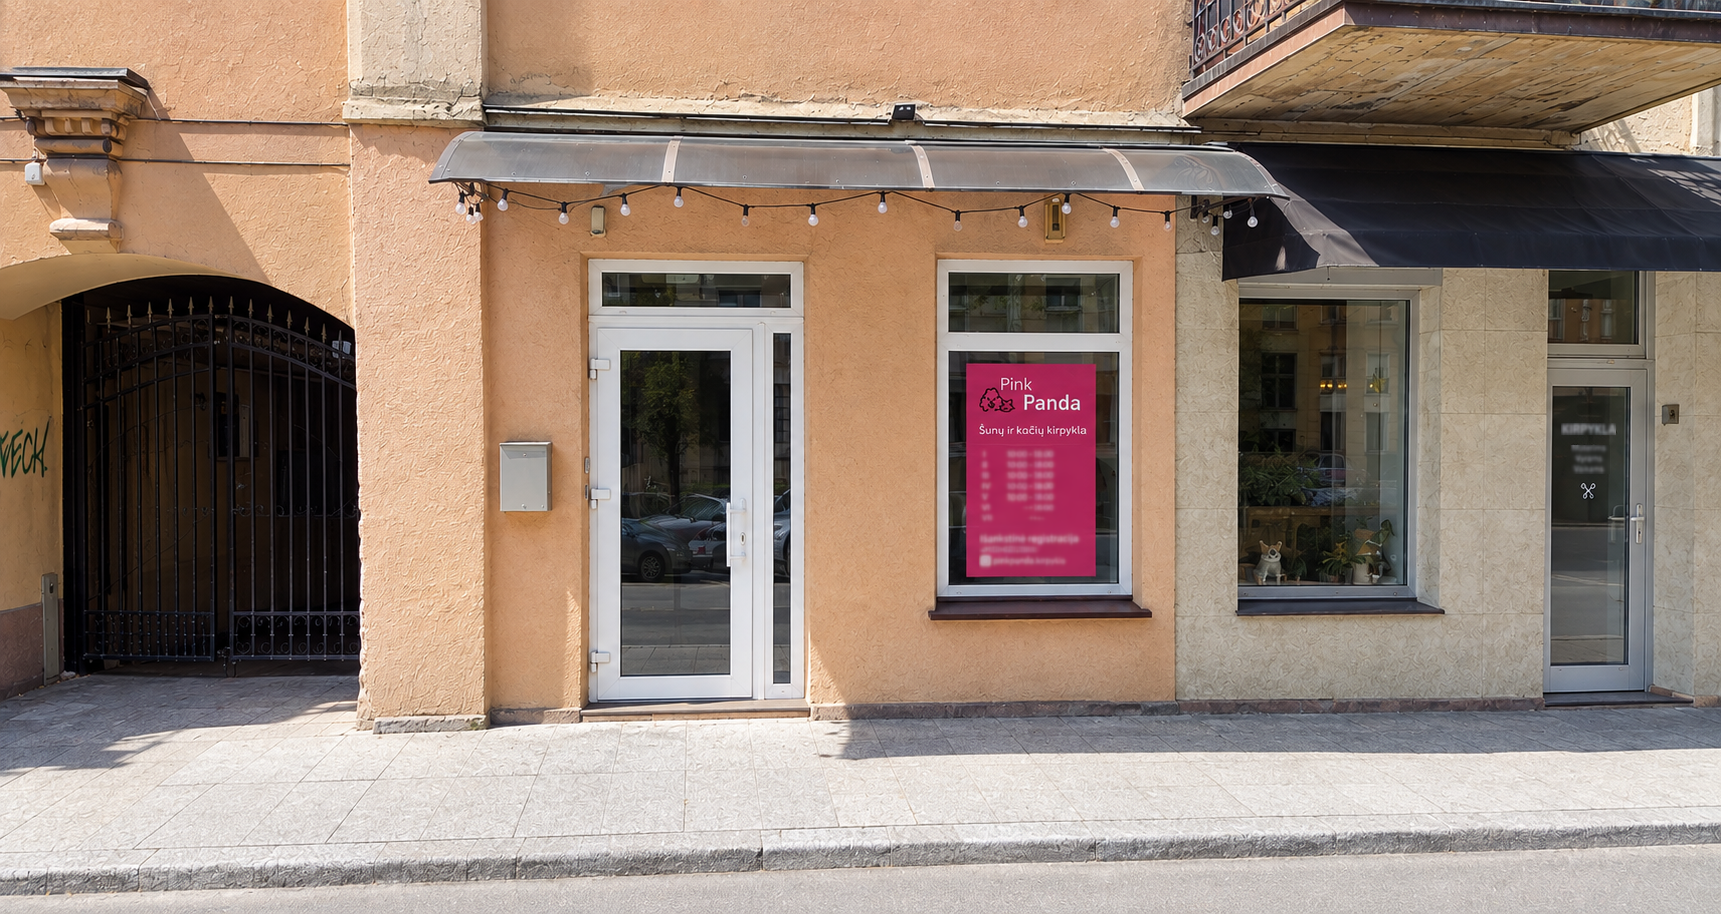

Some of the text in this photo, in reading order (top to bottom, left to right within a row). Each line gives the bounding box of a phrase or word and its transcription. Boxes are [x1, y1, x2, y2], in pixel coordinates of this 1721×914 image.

[1000, 377, 1032, 391] Pink
[1024, 394, 1081, 411] Panda
[979, 424, 1004, 437] Šunų
[1007, 426, 1014, 435] ir
[1047, 426, 1087, 437] kirpykla
